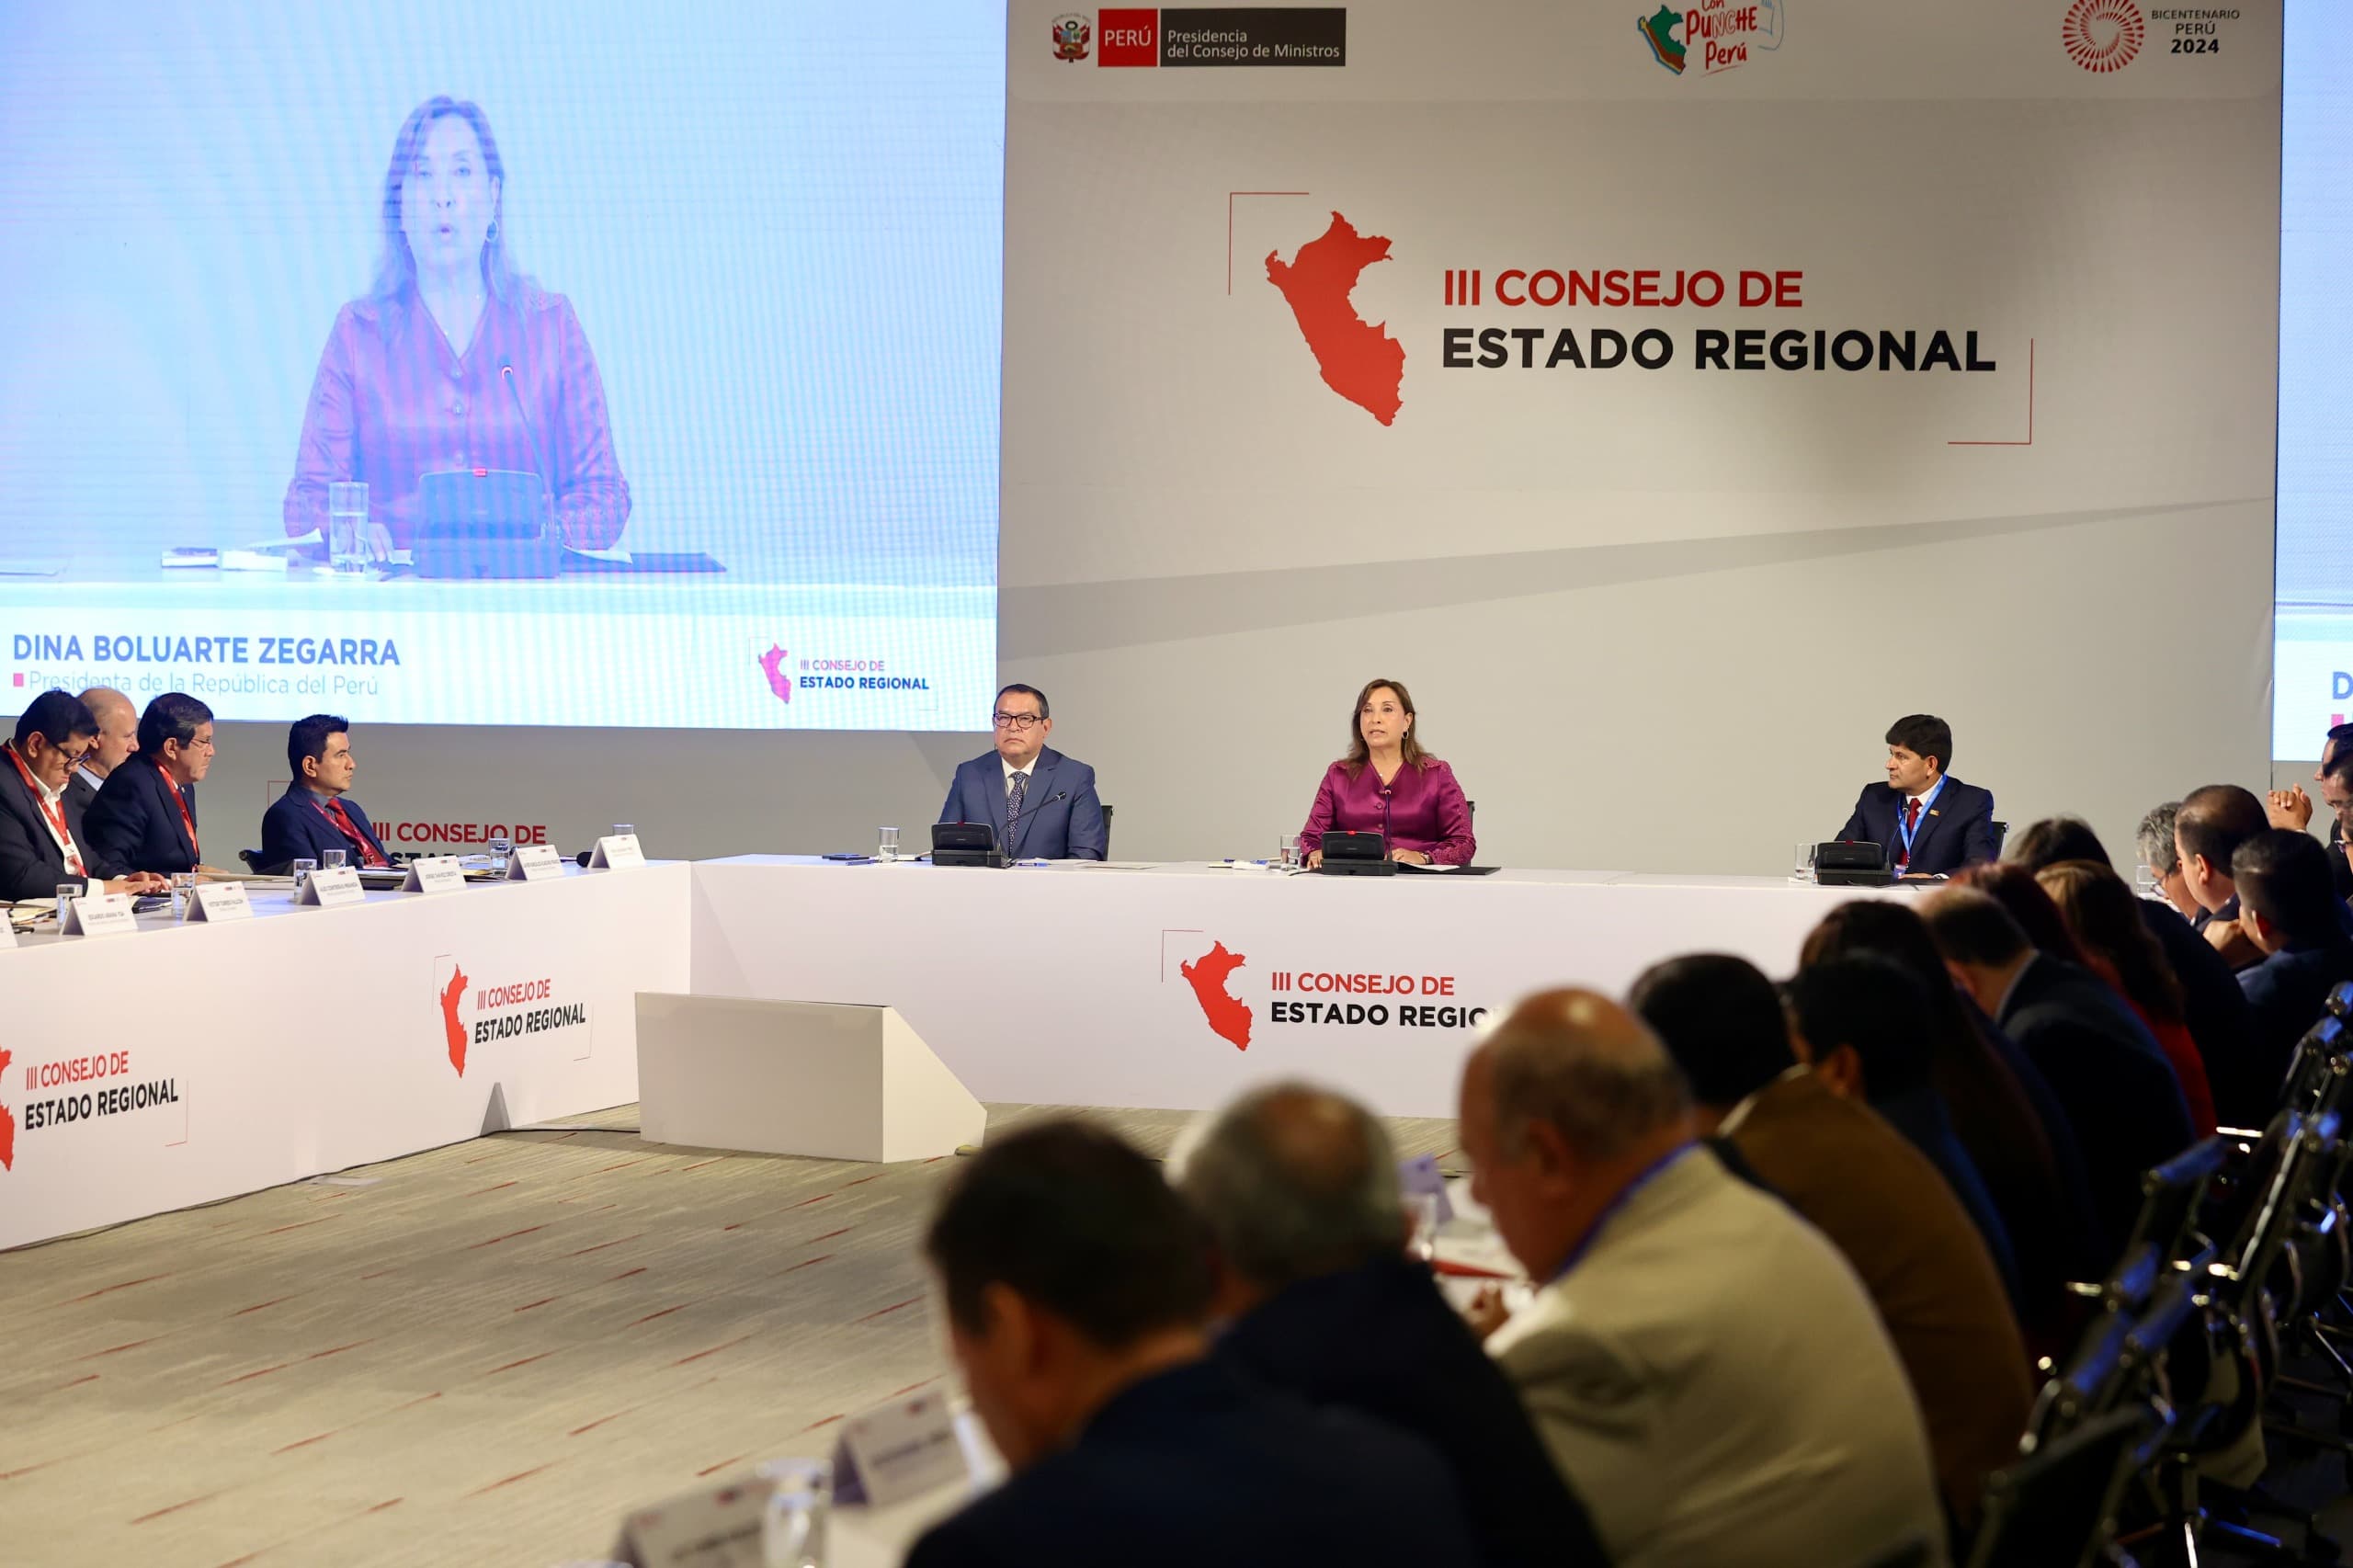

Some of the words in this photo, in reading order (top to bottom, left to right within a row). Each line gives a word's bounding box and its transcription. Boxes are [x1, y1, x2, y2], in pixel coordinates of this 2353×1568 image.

[2152, 9, 2240, 19] BICENTENARIO
[1105, 26, 1152, 46] PERÚ
[1167, 29, 1247, 43] Presidencia
[2176, 20, 2215, 35] PERÚ
[1167, 45, 1188, 58] del
[1193, 45, 1249, 60] Consejo
[1252, 45, 1270, 58] de
[1274, 45, 1339, 58] Ministros
[1705, 41, 1747, 70] Perú
[2170, 39, 2220, 53] 2024
[1445, 269, 1481, 306] III
[1495, 269, 1724, 307] CONSEJO
[1739, 271, 1803, 307] DE
[1443, 328, 1673, 369] ESTADO
[1695, 330, 1996, 372] REGIONAL
[13, 634, 84, 661] DINA
[94, 635, 248, 664] BOLUARTE
[259, 637, 400, 665] ZEGARRA
[801, 659, 809, 670] III
[813, 659, 867, 671] CONSEJO
[870, 661, 884, 671] DE
[30, 671, 131, 690] Presidenta
[140, 673, 163, 691] de
[170, 672, 185, 691] la
[193, 673, 289, 696] República
[297, 675, 325, 694] del
[334, 676, 378, 695] Perú
[800, 676, 855, 688] ESTADO
[859, 677, 929, 689] REGIONAL
[397, 823, 507, 843] CONSEJO
[515, 825, 546, 845] DE
[477, 990, 486, 1010] III
[488, 981, 535, 1008] CONSEJO
[537, 978, 551, 1000] DE
[1271, 972, 1291, 992] III
[1298, 972, 1415, 995] CONSEJO
[1422, 976, 1454, 995] DE
[474, 1014, 523, 1044] ESTADO
[526, 1003, 585, 1033] REGIONAL
[1271, 1002, 1389, 1027] ESTADO
[1399, 1006, 1489, 1028] REGIO
[26, 1066, 38, 1091] III
[41, 1054, 107, 1088] CONSEJO
[110, 1051, 129, 1075] DE
[26, 1094, 92, 1131] ESTADO
[97, 1078, 178, 1117] REGIONAL
